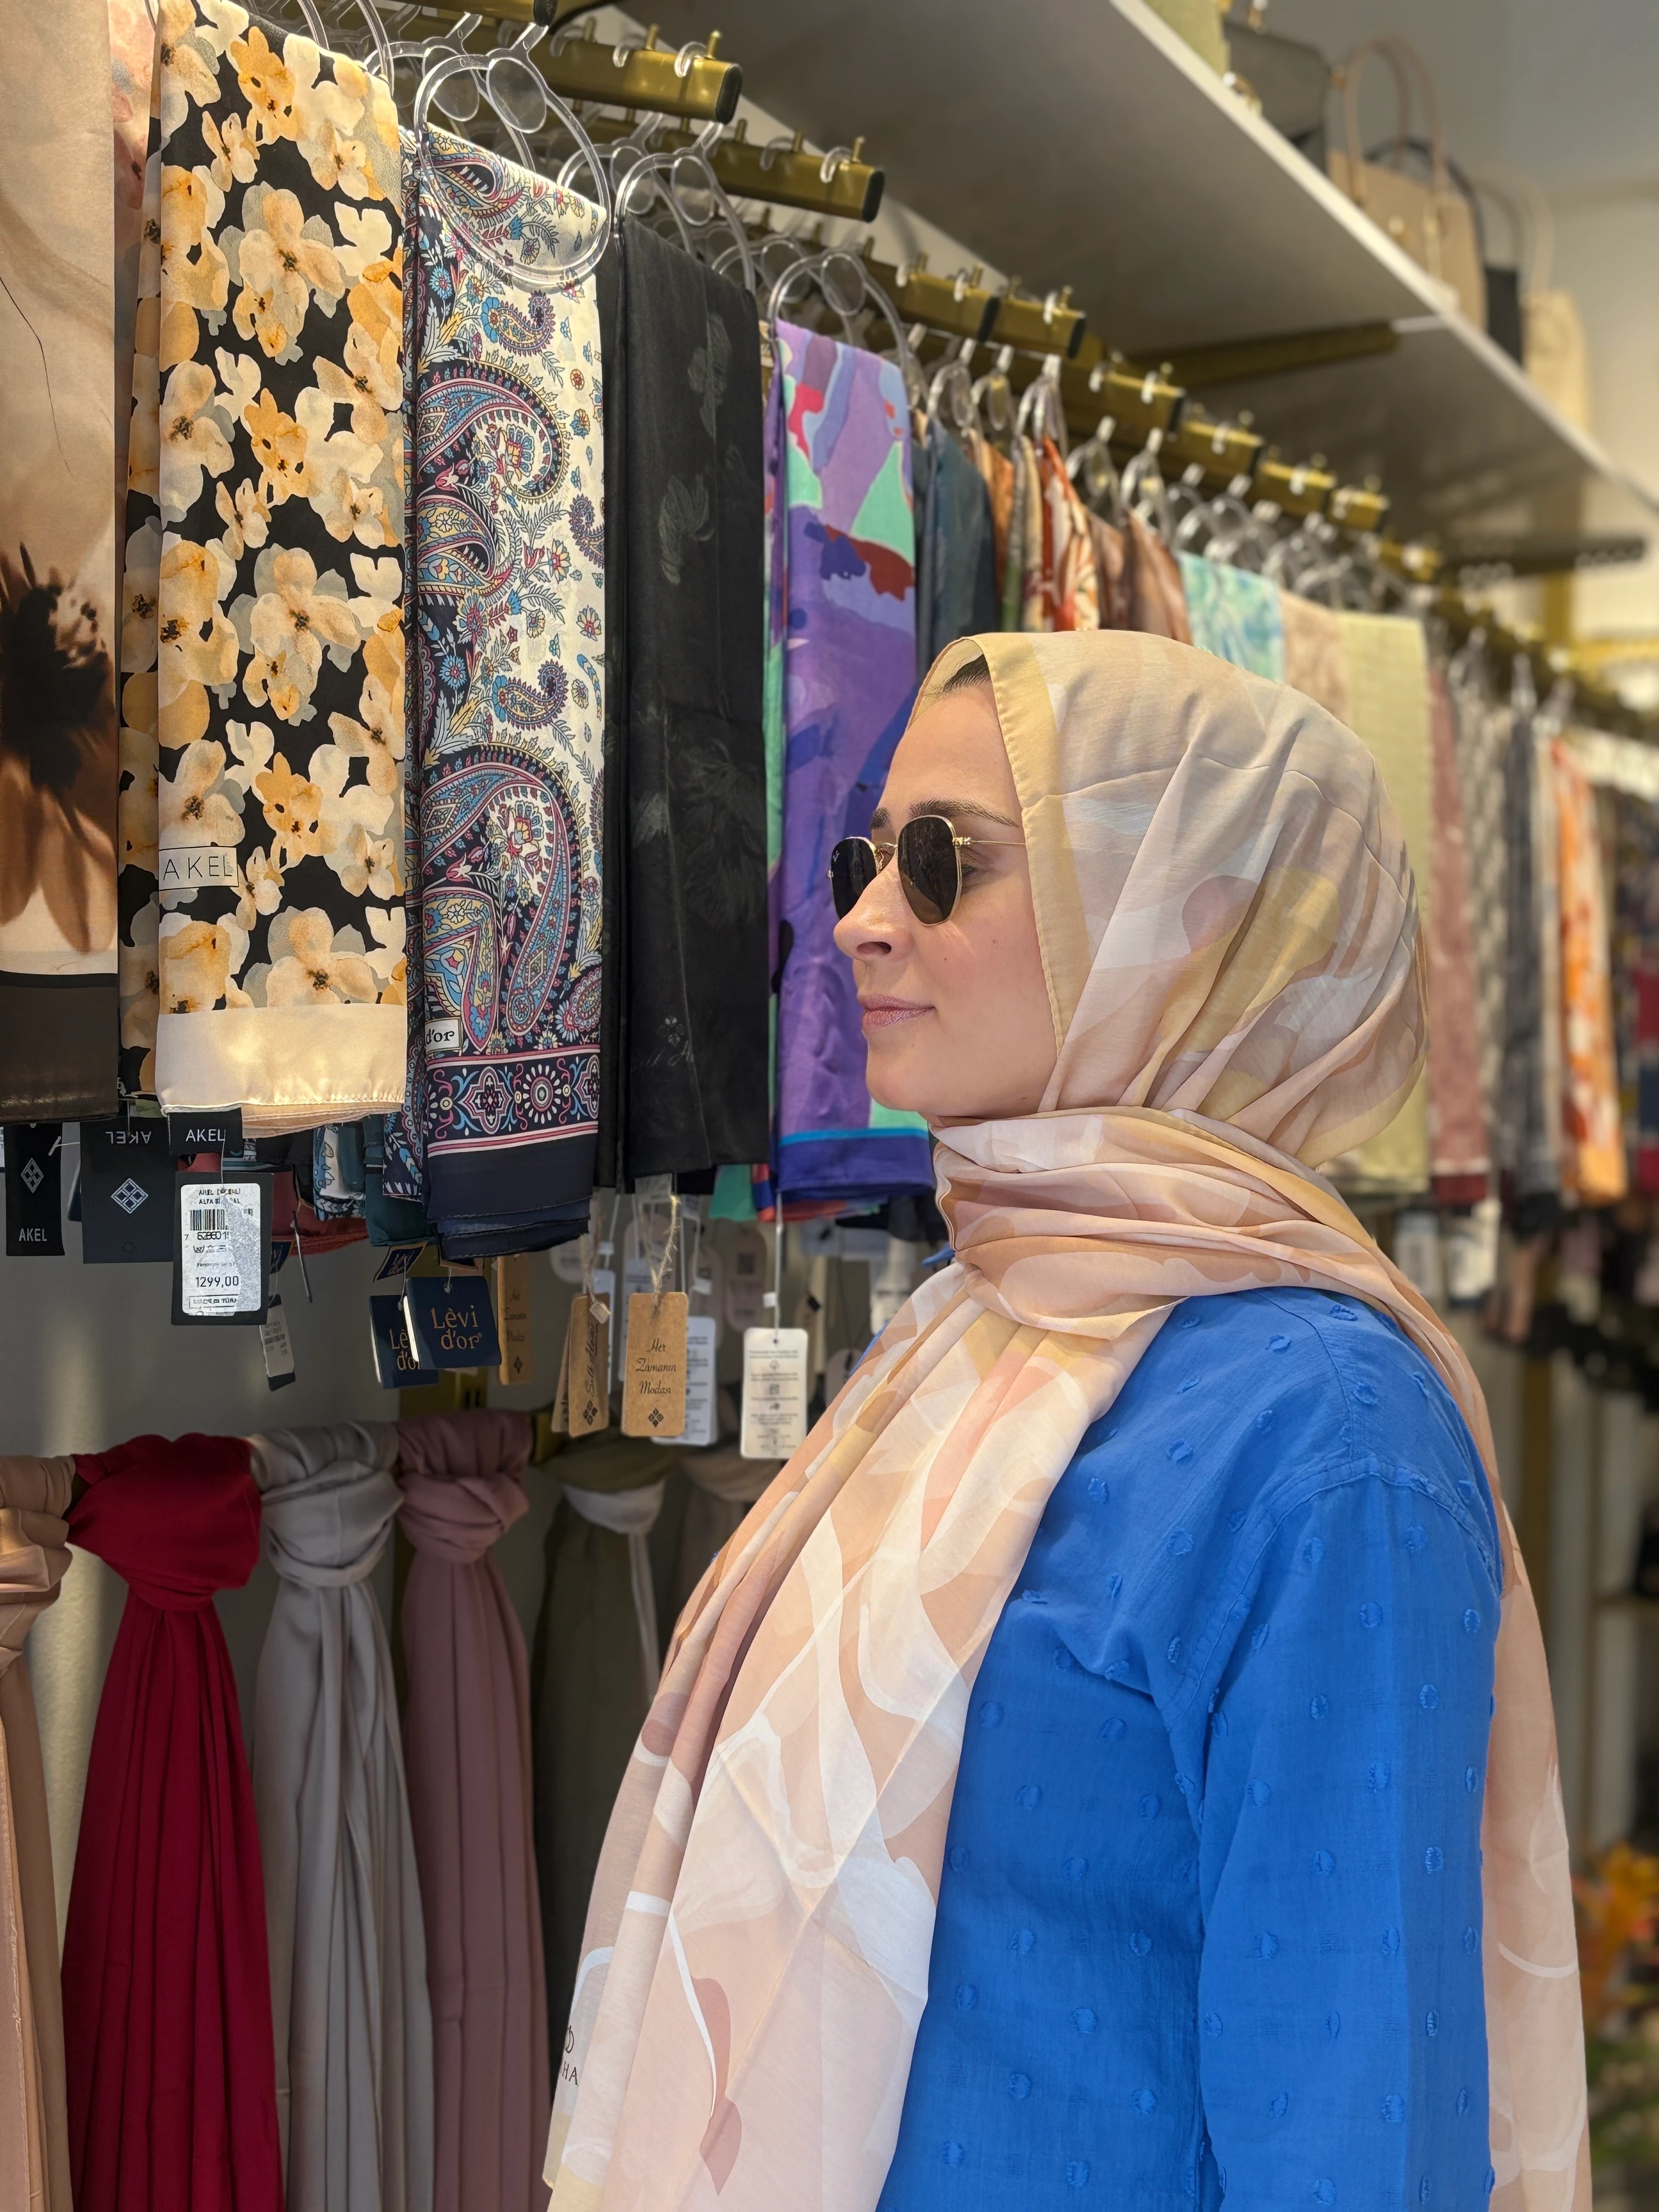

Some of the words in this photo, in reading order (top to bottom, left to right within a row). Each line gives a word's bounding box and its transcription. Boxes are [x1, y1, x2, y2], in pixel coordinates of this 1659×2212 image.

[163, 854, 233, 881] AKEL
[426, 1029, 455, 1045] d'or
[105, 1131, 152, 1144] AKEL
[185, 1128, 225, 1142] AKEL
[19, 1228, 48, 1242] AKEL
[195, 1276, 239, 1288] 1299,00
[431, 1305, 479, 1329] Lêvi
[389, 1328, 408, 1350] Lê
[646, 1338, 666, 1352] Her
[562, 2061, 578, 2085] HA
